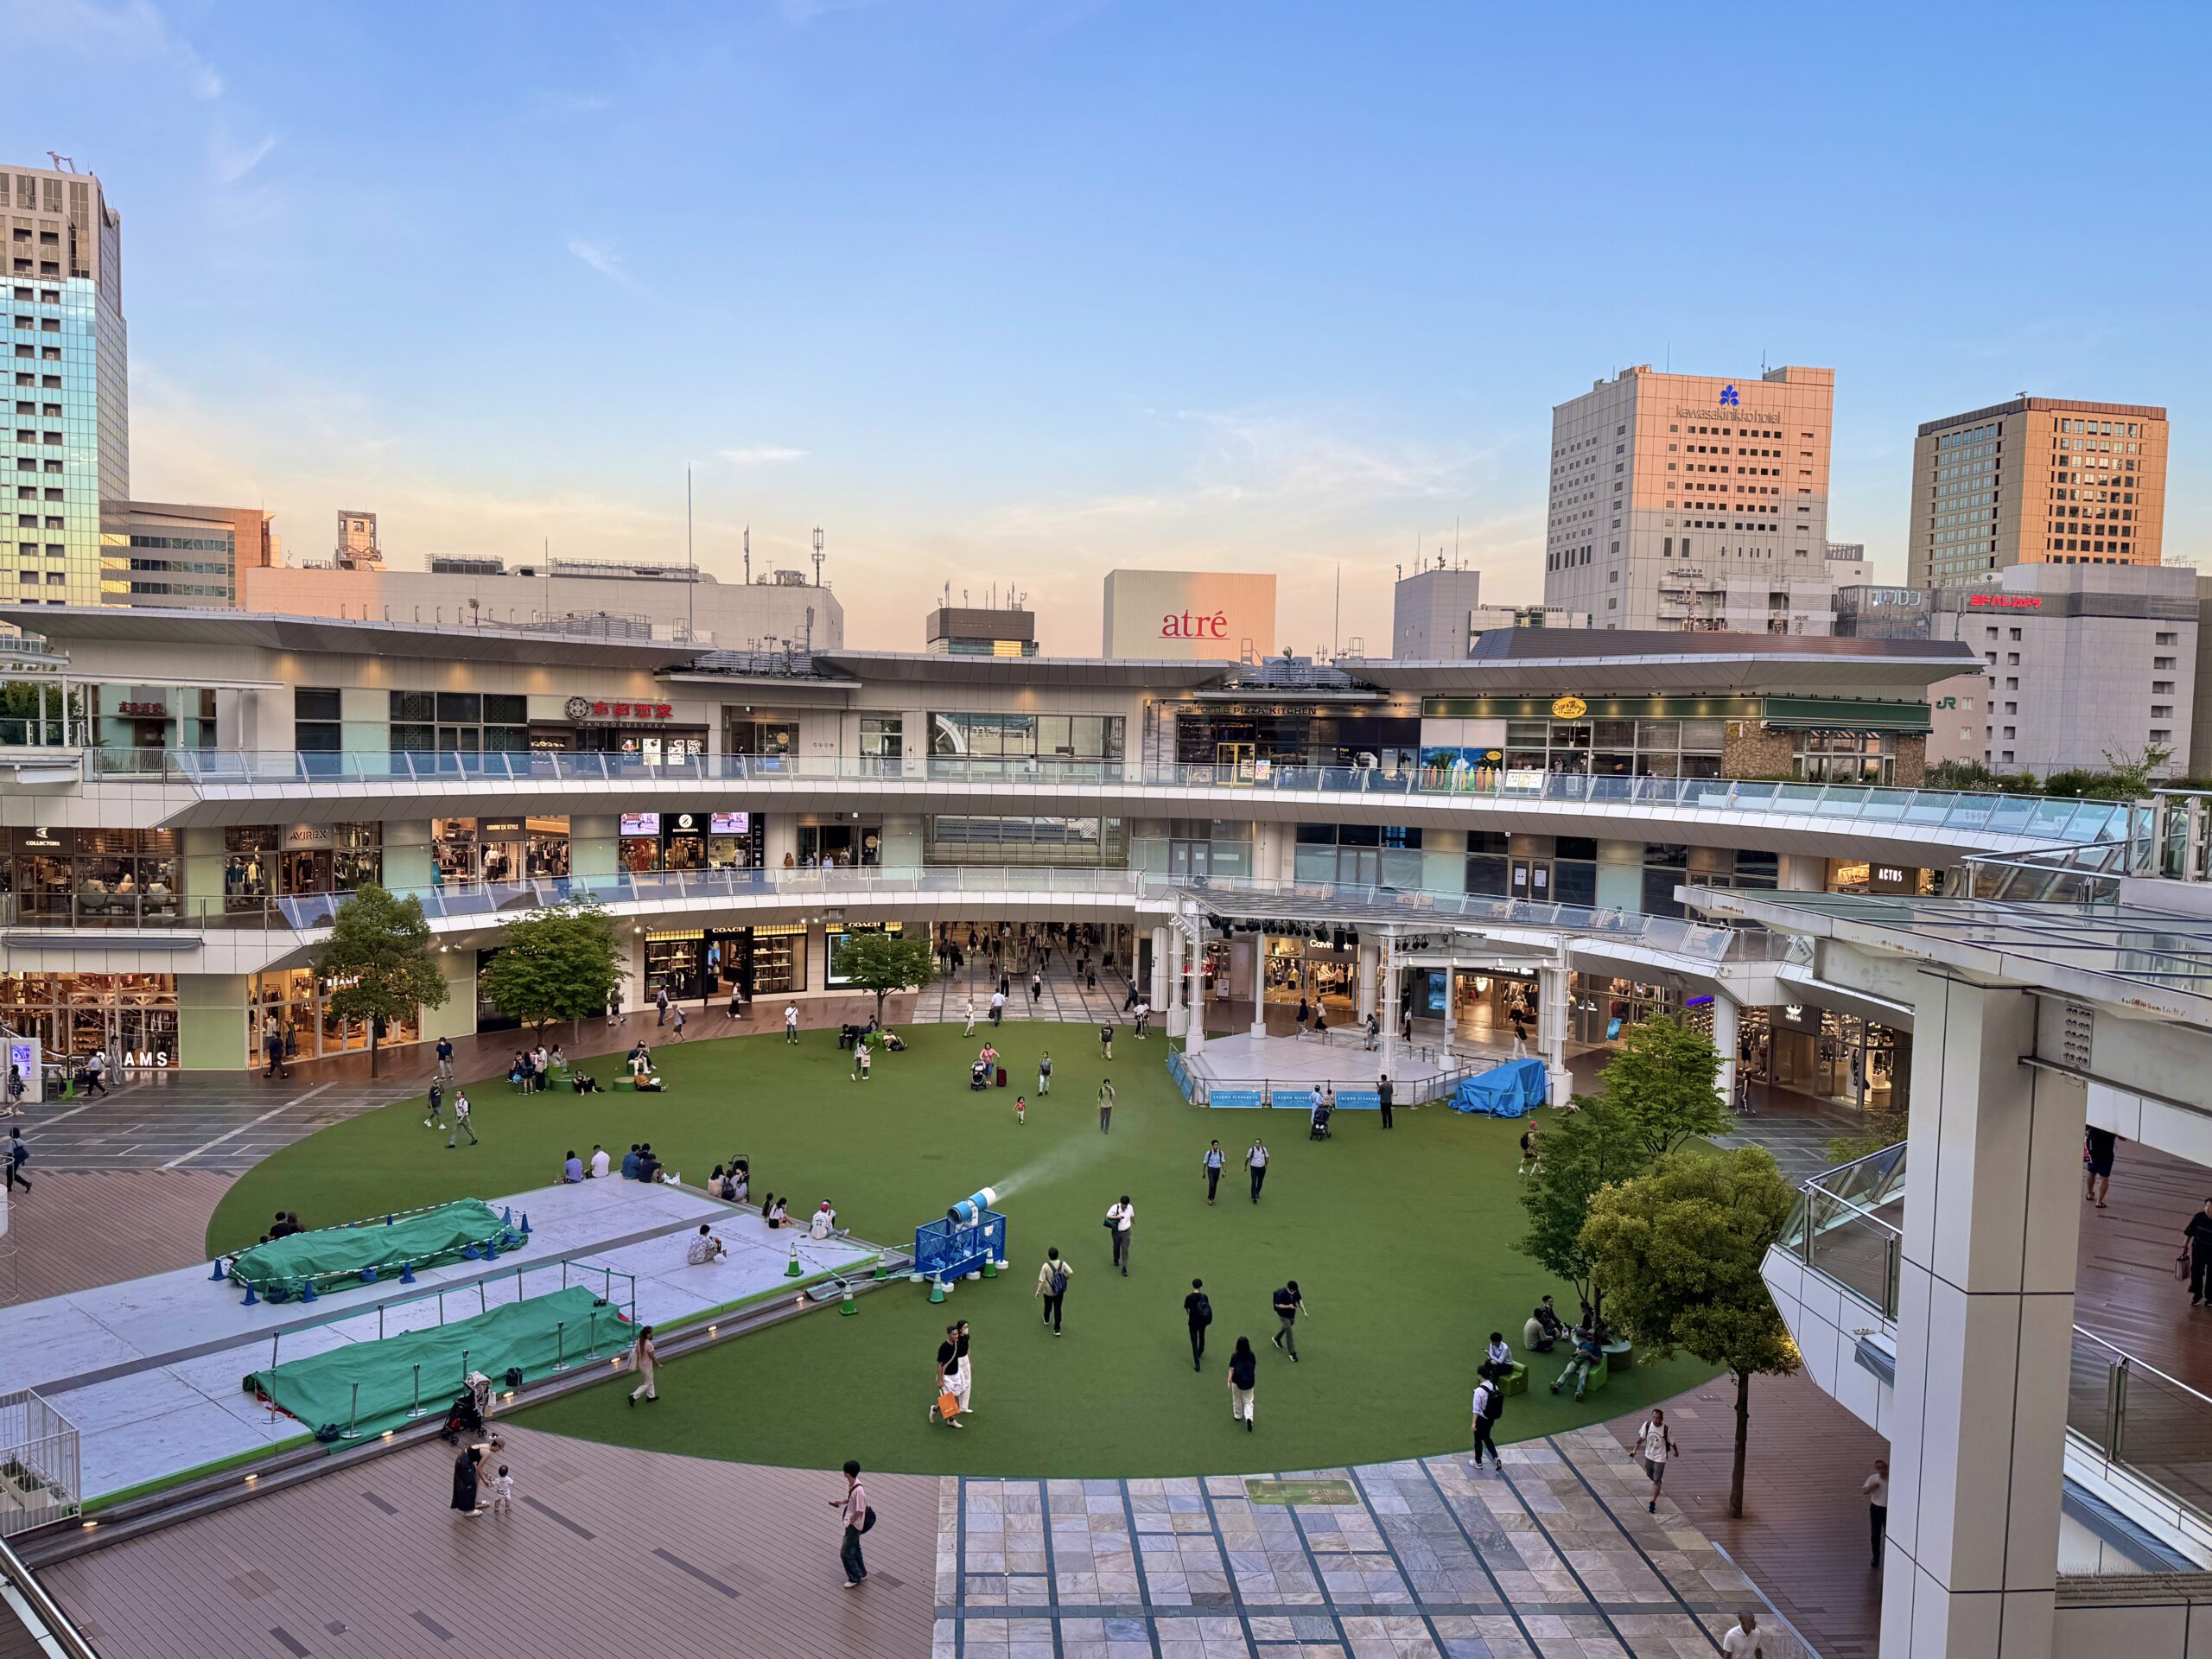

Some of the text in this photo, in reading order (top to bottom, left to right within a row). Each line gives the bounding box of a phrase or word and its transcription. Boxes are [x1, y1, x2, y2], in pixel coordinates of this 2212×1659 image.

[1162, 609, 1228, 638] atré
[1936, 697, 1955, 709] JR
[1178, 704, 1230, 713] california
[290, 830, 327, 840] AVIREX
[1878, 868, 1903, 881] ACTUS
[1309, 939, 1333, 949] Calvin
[327, 976, 359, 986] BEAMS
